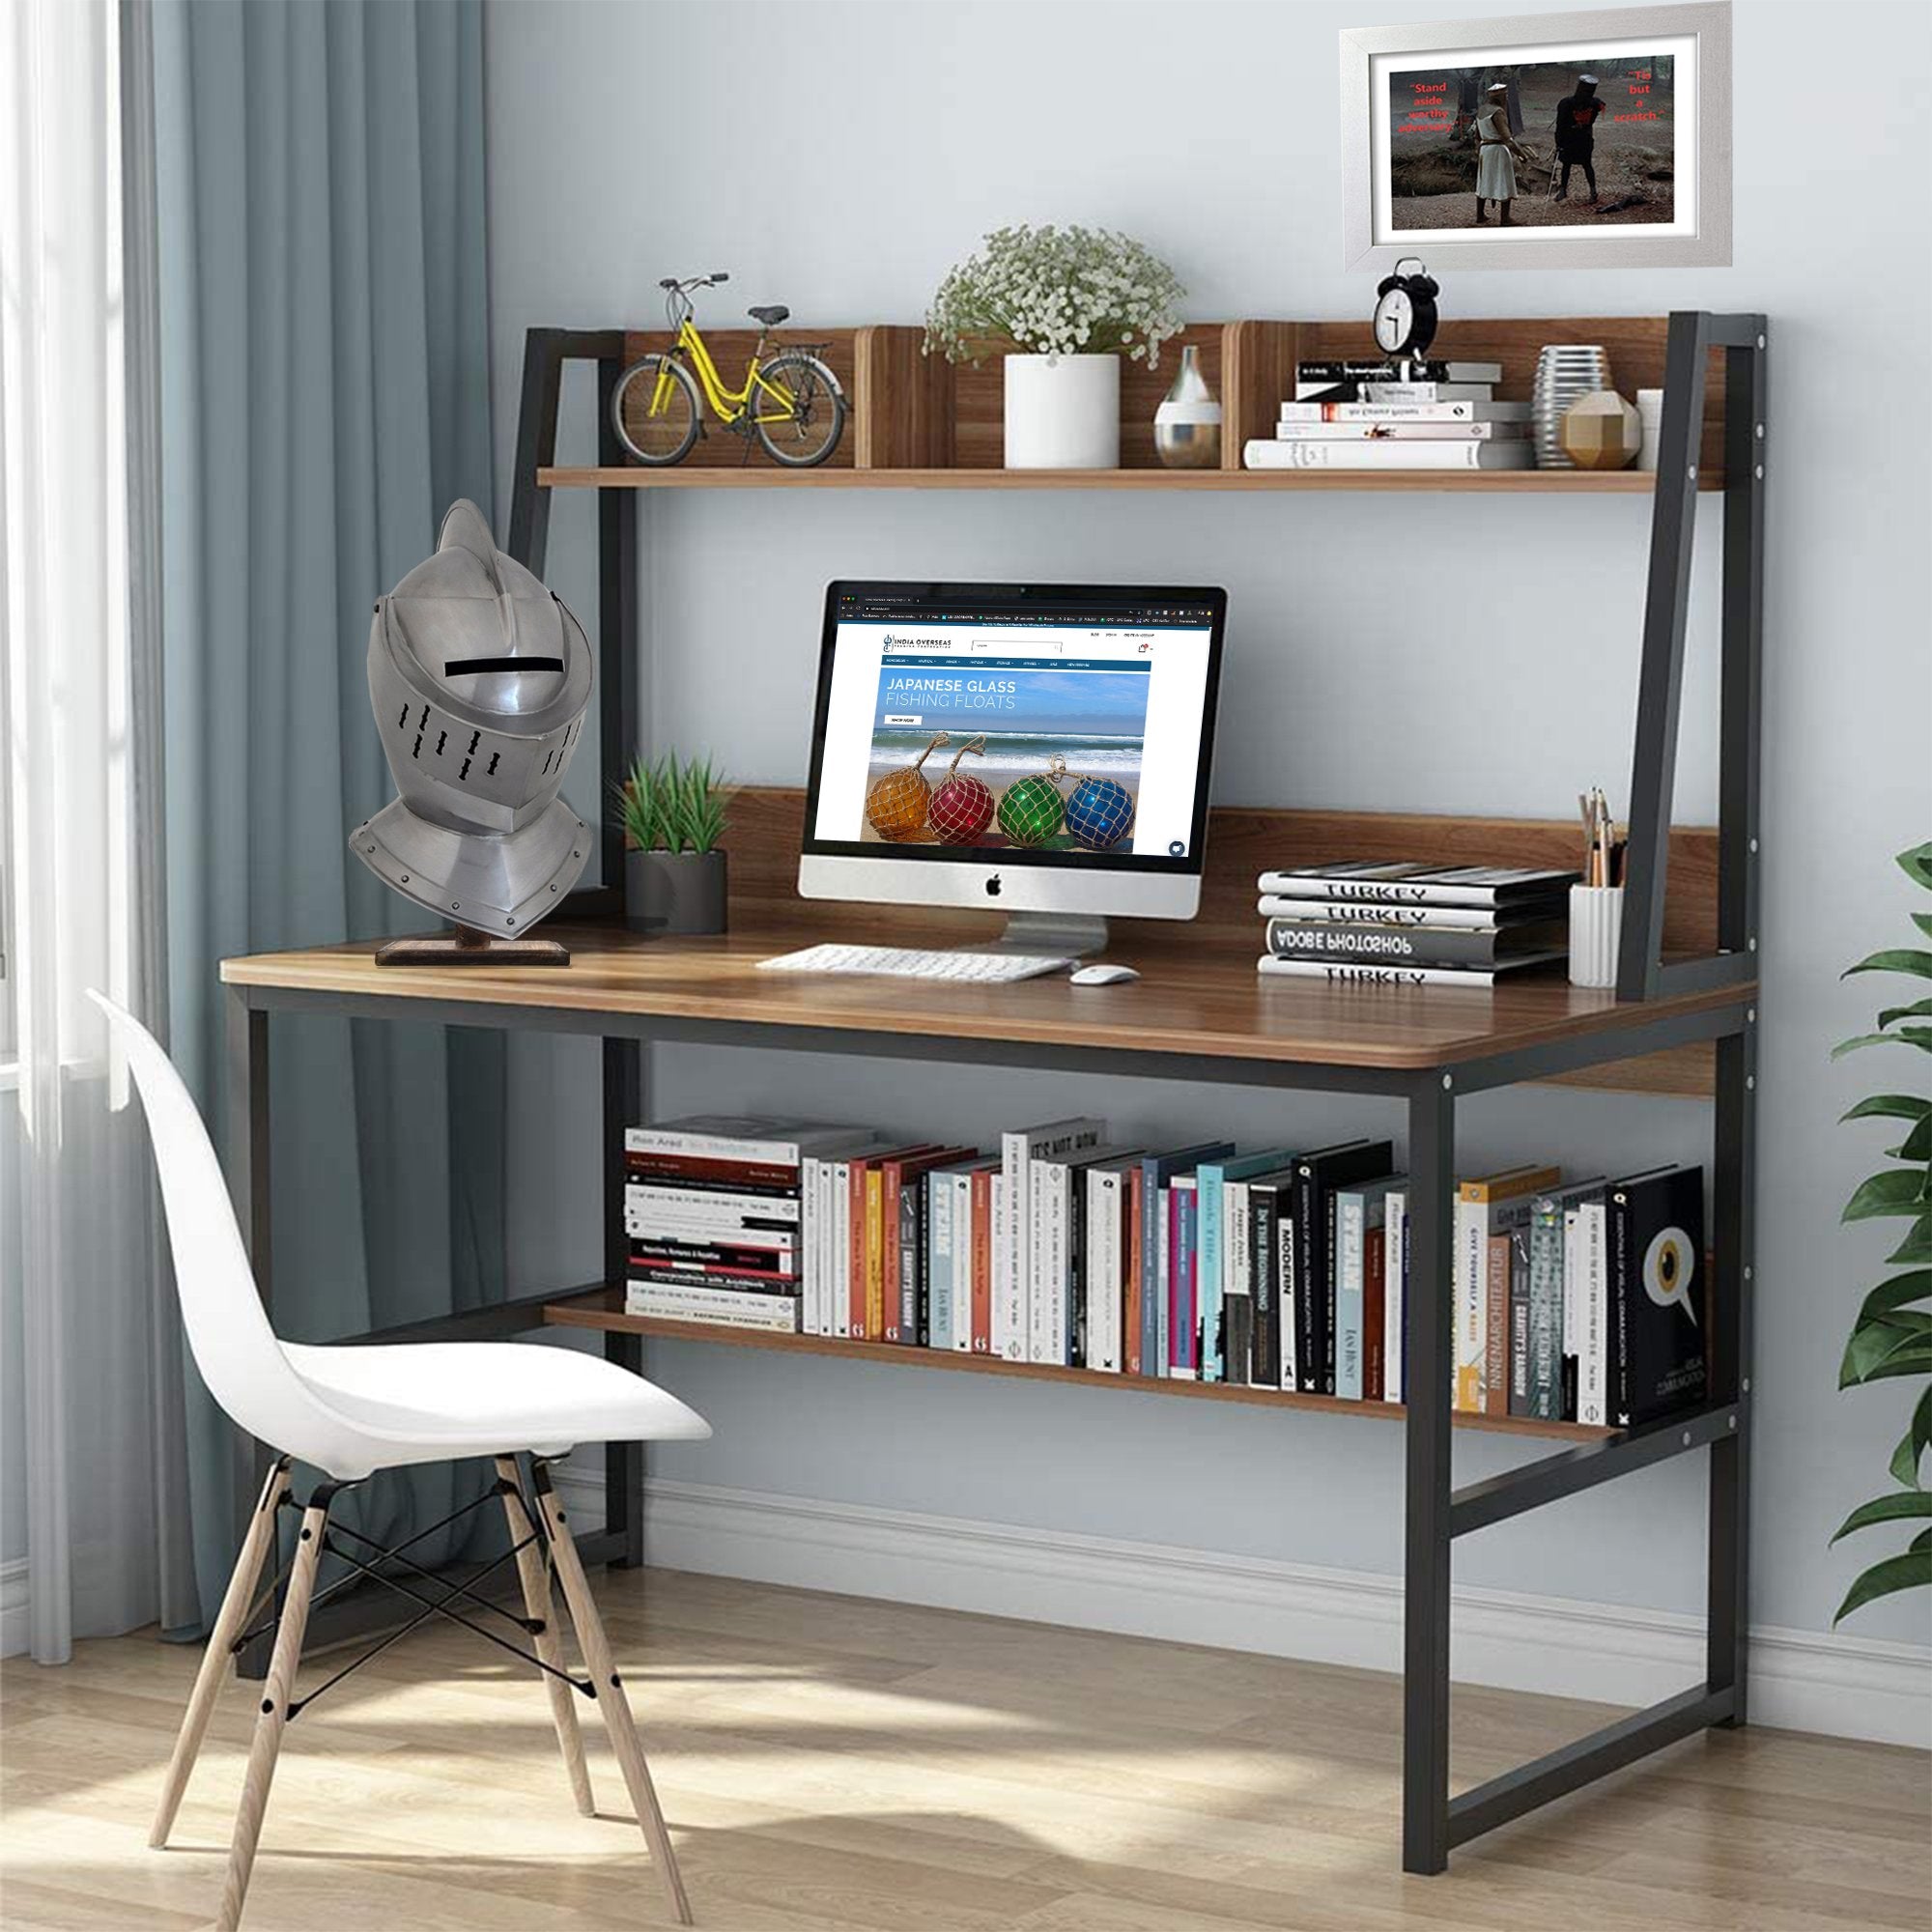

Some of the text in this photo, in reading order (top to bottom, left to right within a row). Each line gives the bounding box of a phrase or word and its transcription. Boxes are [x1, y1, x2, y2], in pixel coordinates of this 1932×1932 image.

[1629, 84, 1651, 95] but
[1413, 96, 1443, 107] aside
[1635, 99, 1643, 108] a
[1407, 108, 1449, 120] worthy
[887, 678, 1016, 694] JAPANESE GLASS
[886, 692, 1016, 709] FISHING FLOATS
[1323, 883, 1426, 900] TURKEY
[1323, 905, 1426, 923] TURKEY
[1323, 967, 1426, 985] TURKEY
[1257, 1208, 1268, 1311] IN THE BEGINNING
[1281, 1229, 1292, 1295] MODERN
[1343, 1204, 1360, 1379] STEAM IAN HUNT
[1490, 1247, 1504, 1390] INNENARCHITEKTUR
[1514, 1305, 1527, 1397] GRAVITY'S RAINBOW
